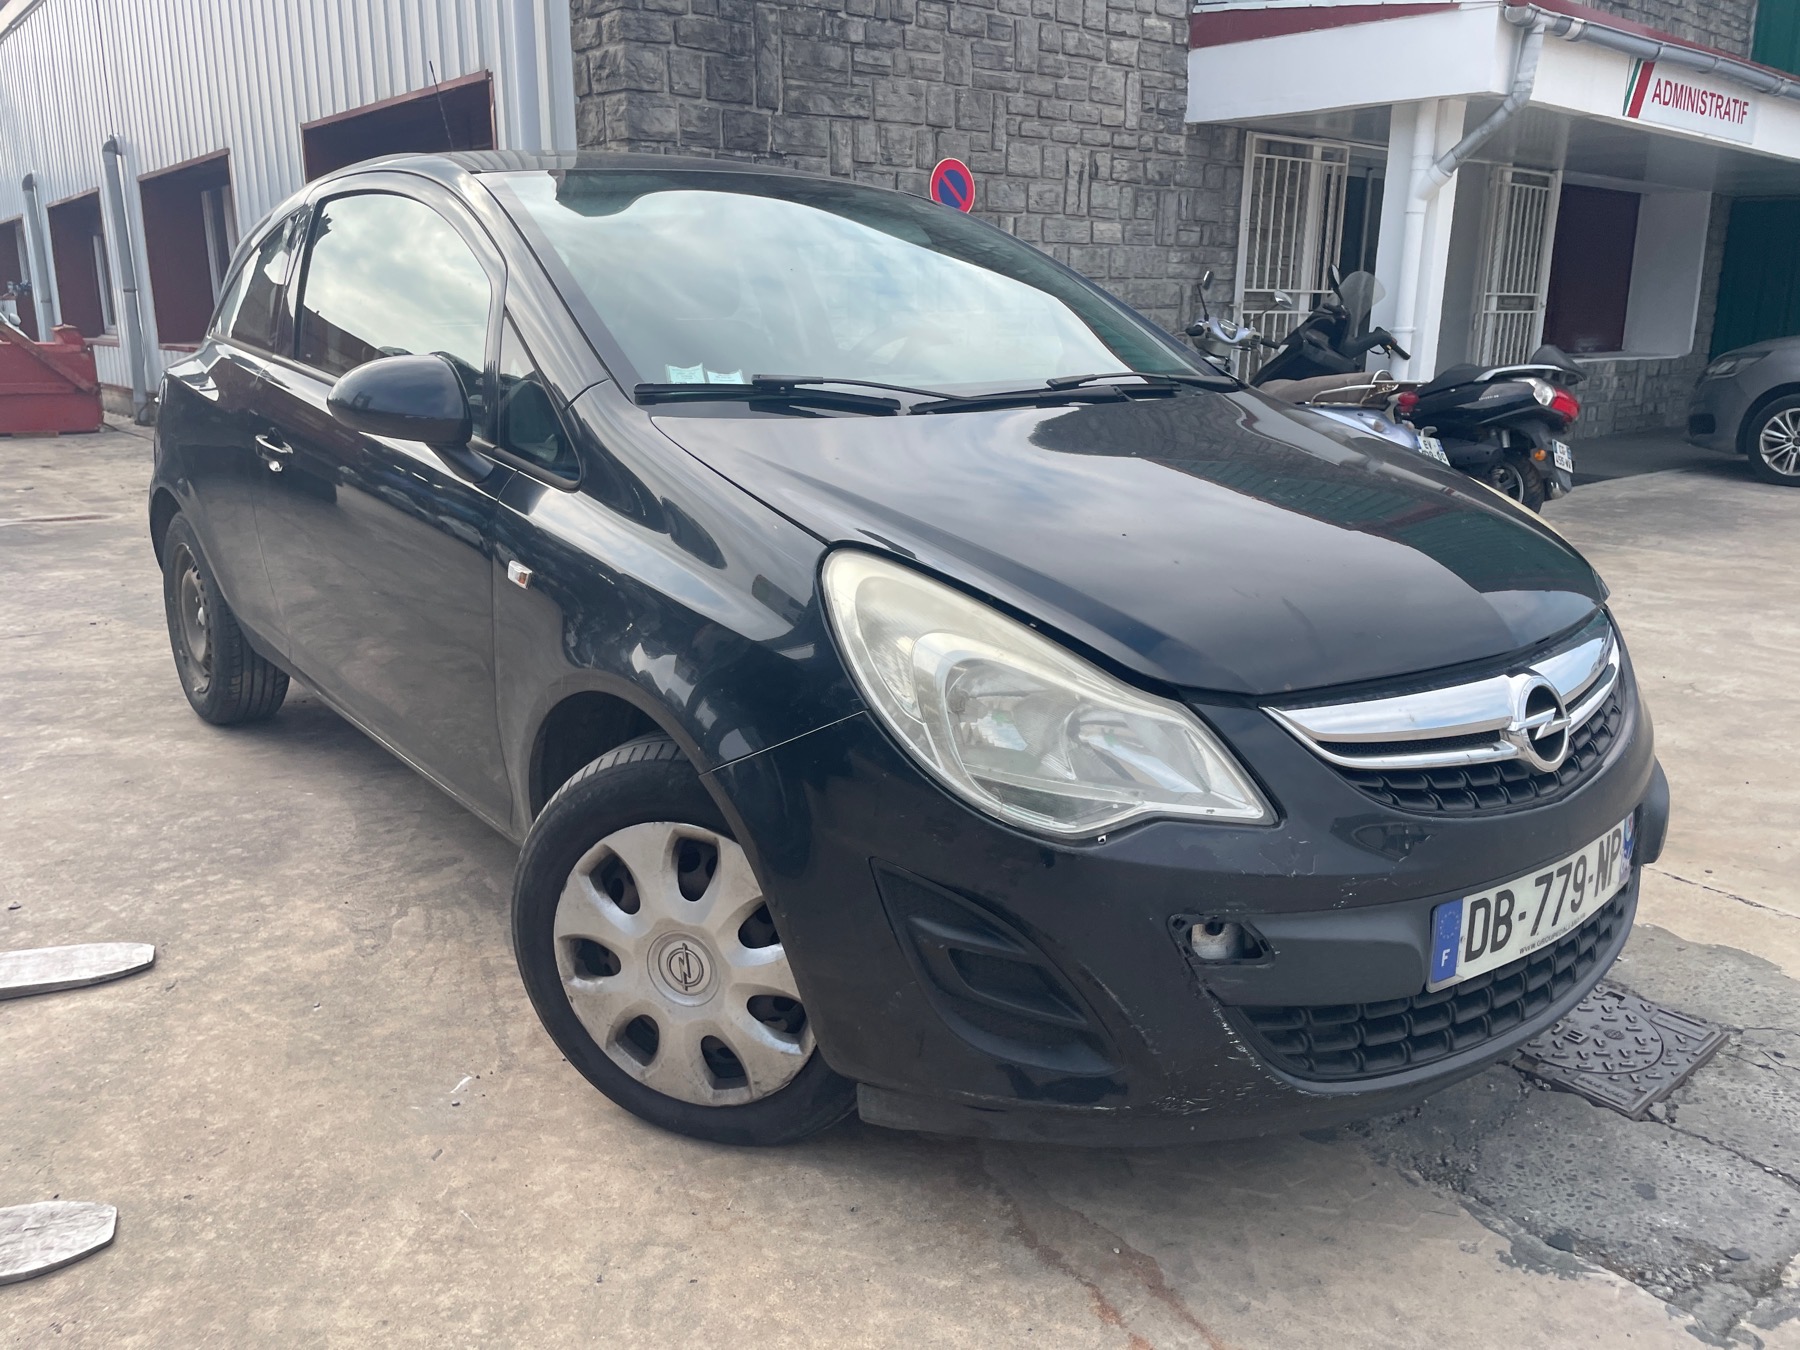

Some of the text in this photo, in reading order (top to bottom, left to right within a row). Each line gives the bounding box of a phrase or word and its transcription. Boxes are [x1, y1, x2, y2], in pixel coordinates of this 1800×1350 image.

[1652, 78, 1749, 124] ADMINISTRATIF
[1441, 828, 1622, 967] F DB-779-NP
